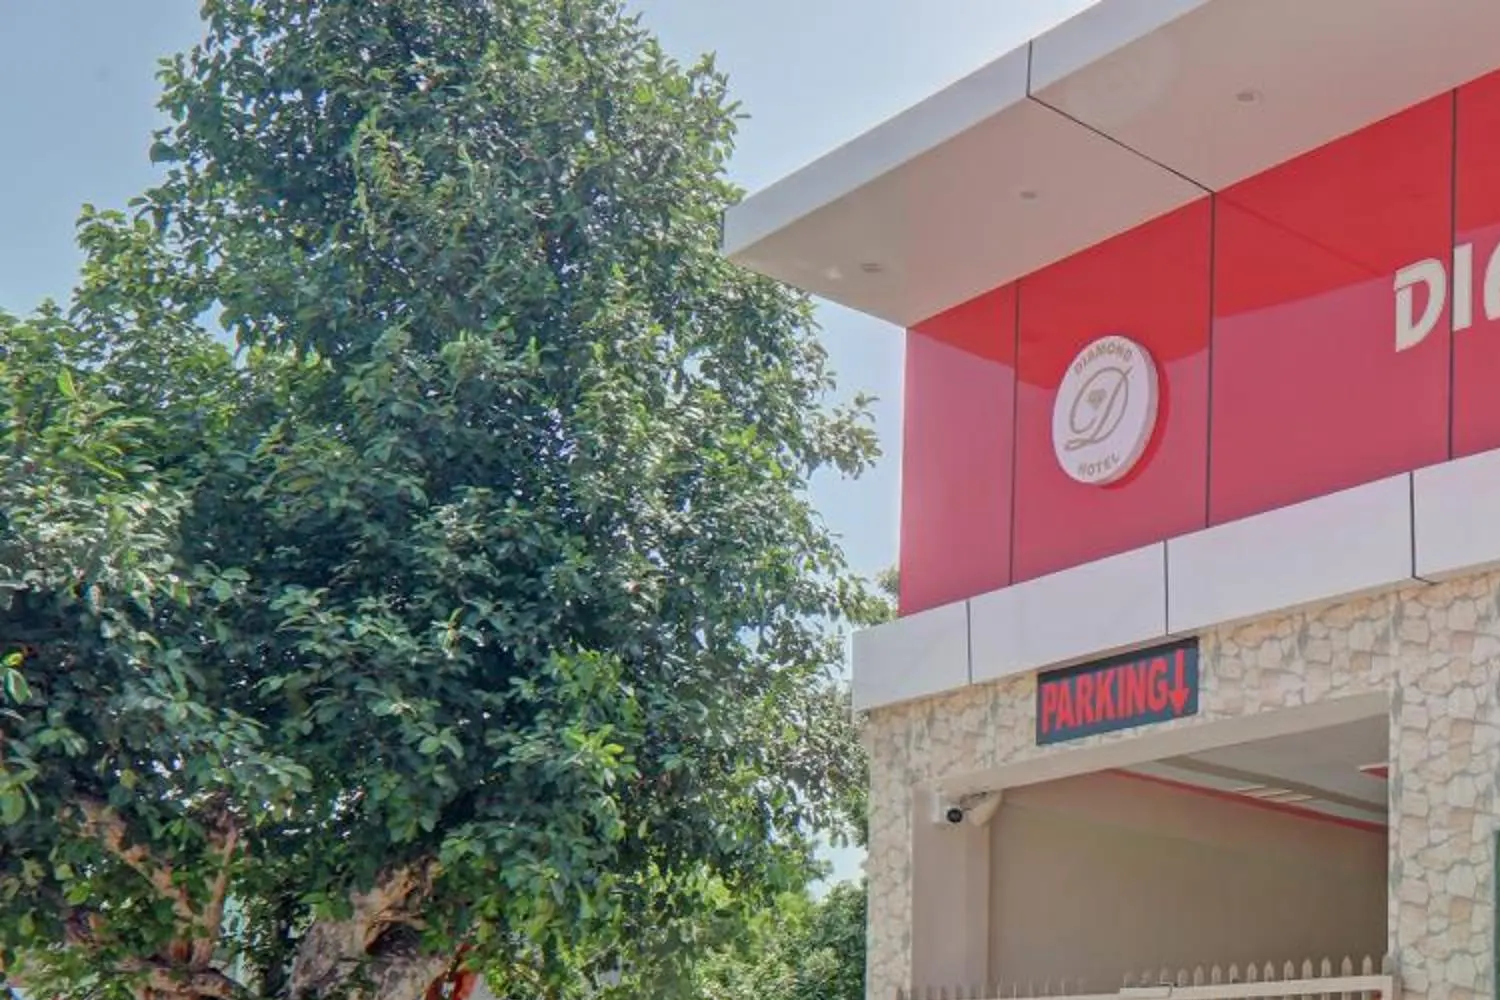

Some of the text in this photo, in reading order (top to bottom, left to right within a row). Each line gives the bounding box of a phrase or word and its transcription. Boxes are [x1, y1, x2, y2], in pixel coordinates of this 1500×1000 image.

[1074, 341, 1133, 375] DIAMOND
[1078, 453, 1120, 477] HOTEL
[1041, 657, 1168, 734] PARKING
